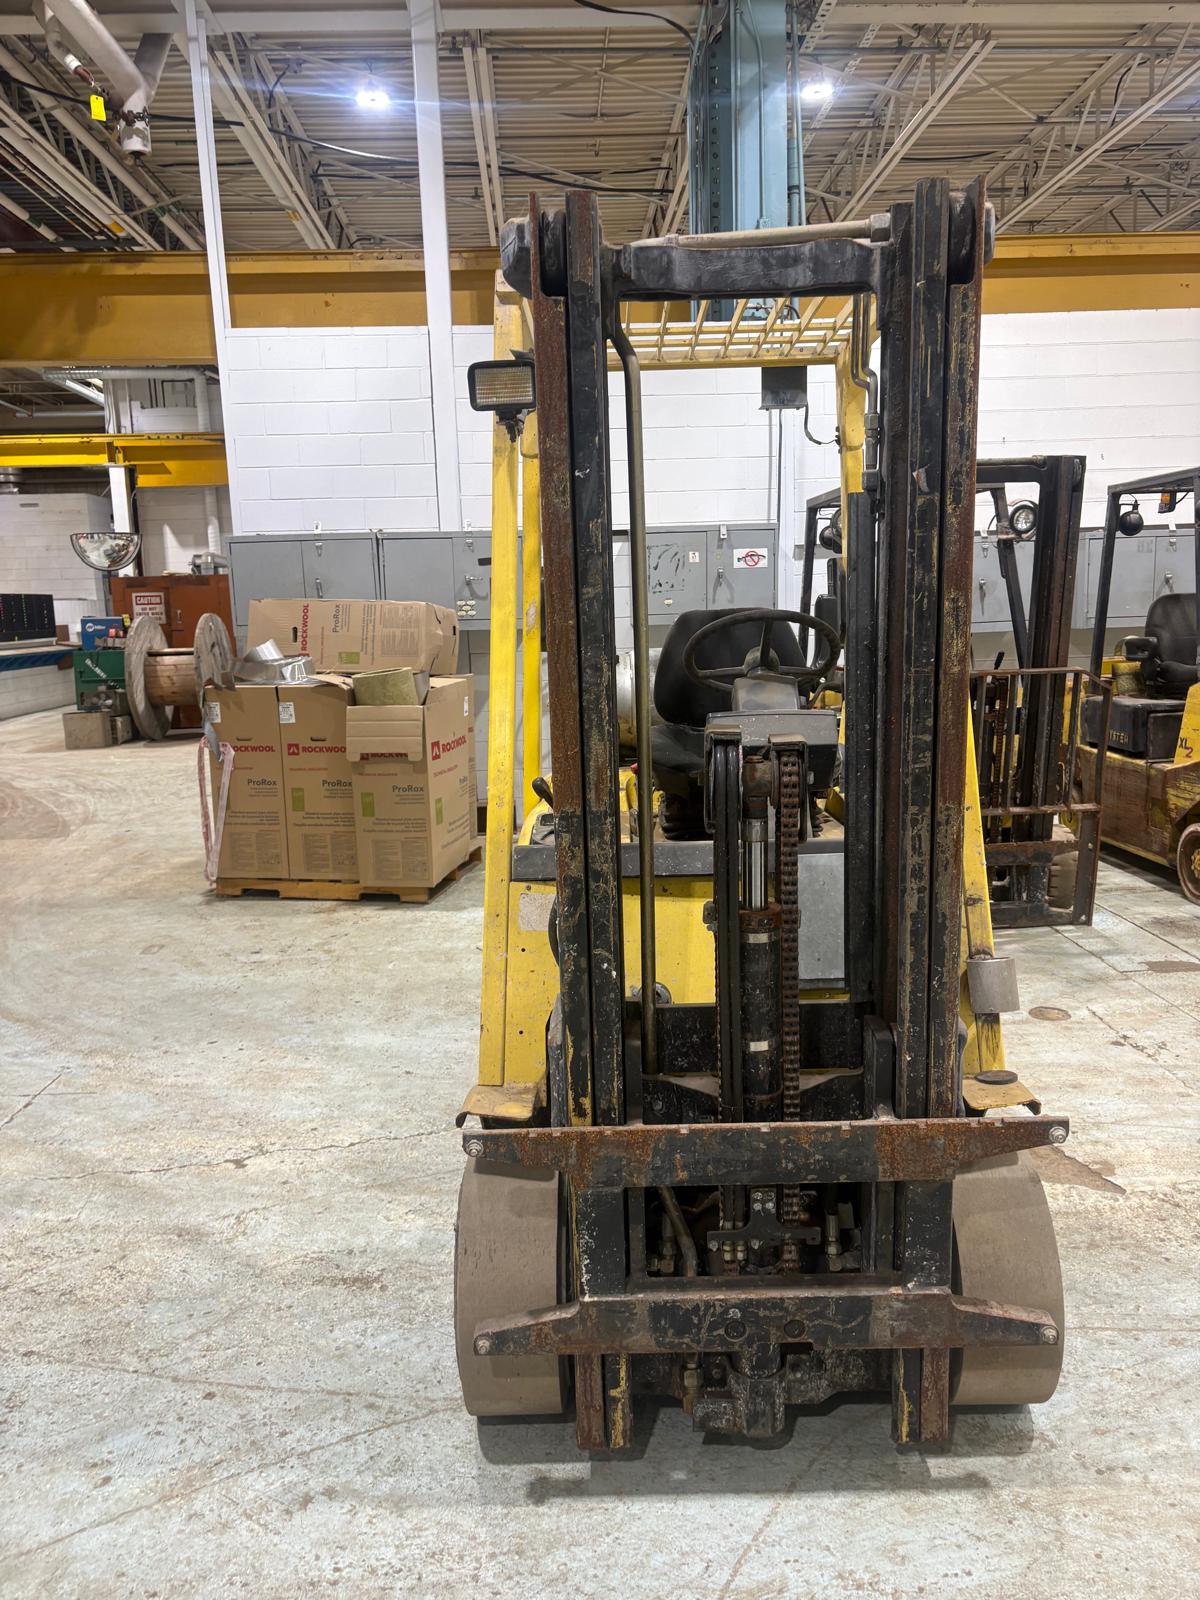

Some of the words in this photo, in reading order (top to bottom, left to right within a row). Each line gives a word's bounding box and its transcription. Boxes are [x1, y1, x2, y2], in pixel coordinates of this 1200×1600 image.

[301, 603, 309, 652] ROCKWOOL
[332, 604, 341, 633] ProRox
[442, 735, 467, 753] ROCKWOOL
[322, 779, 353, 788] ProRox
[392, 784, 424, 793] ProRox
